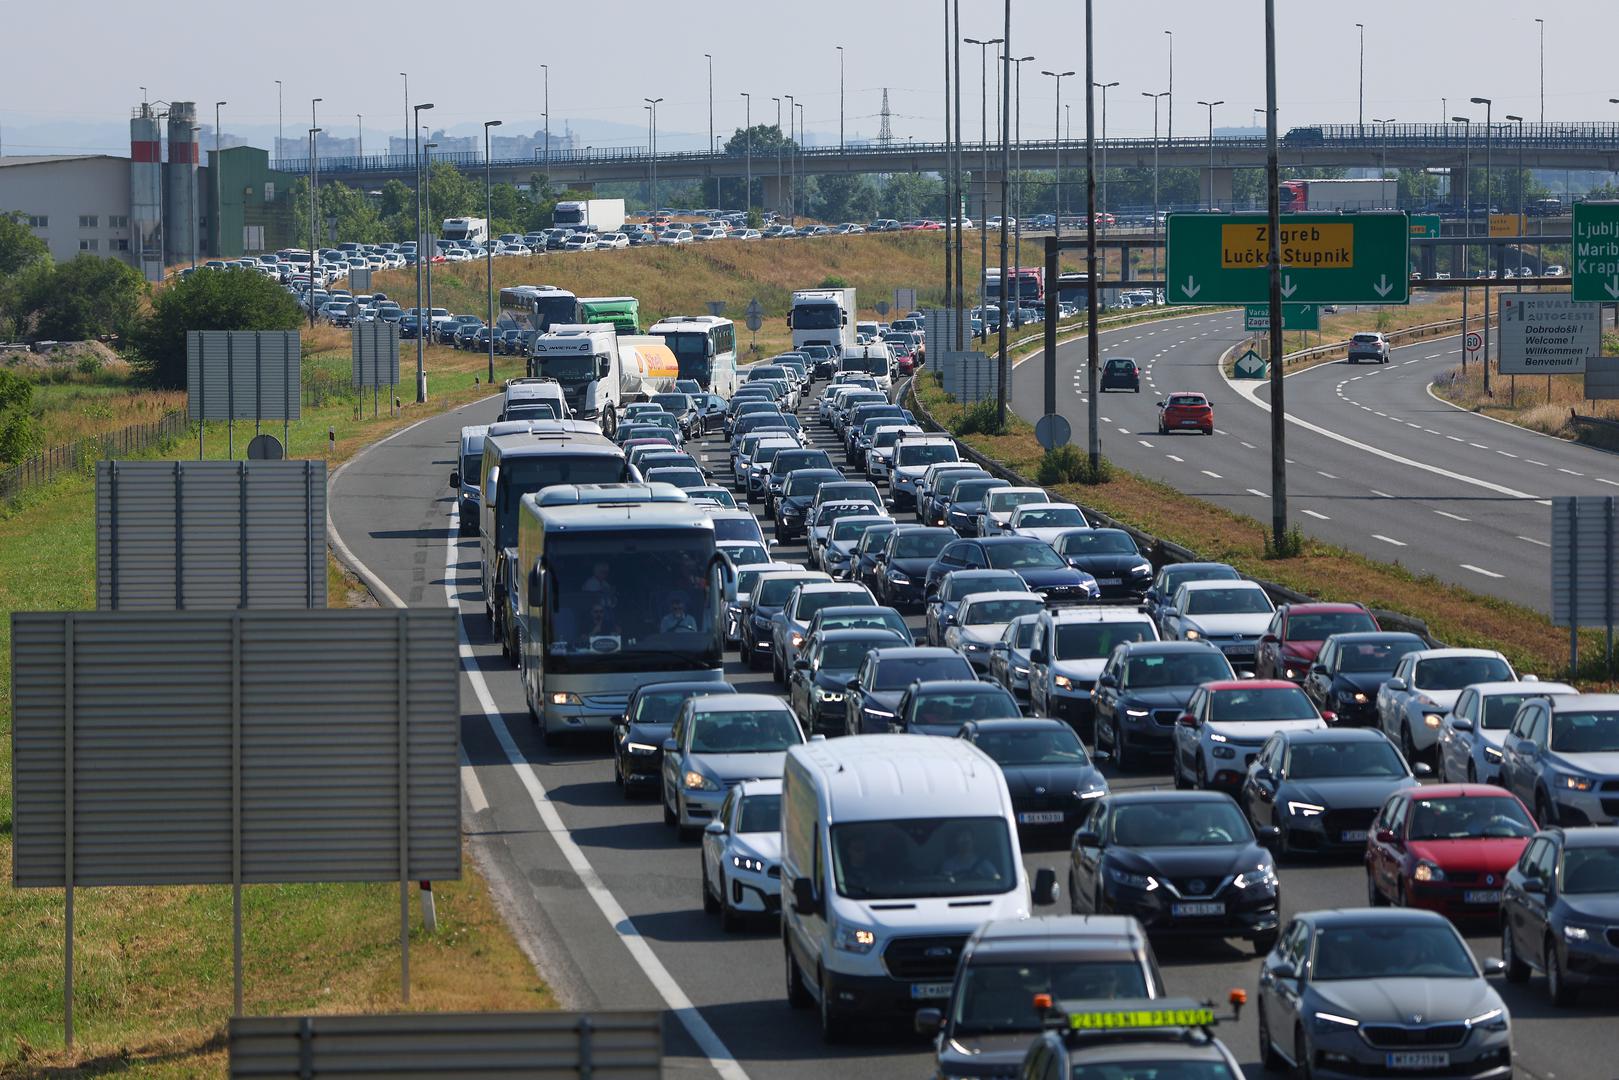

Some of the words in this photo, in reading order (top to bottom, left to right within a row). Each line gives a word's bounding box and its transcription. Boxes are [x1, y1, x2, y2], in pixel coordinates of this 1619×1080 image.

[1256, 227, 1320, 244] Zgreb
[1578, 242, 1619, 257] Marib
[1284, 248, 1350, 266] Stupnik
[1248, 318, 1270, 327] Zagre
[1467, 337, 1478, 347] 60
[1525, 336, 1569, 345] Welcome
[1525, 357, 1573, 366] Benvenuti
